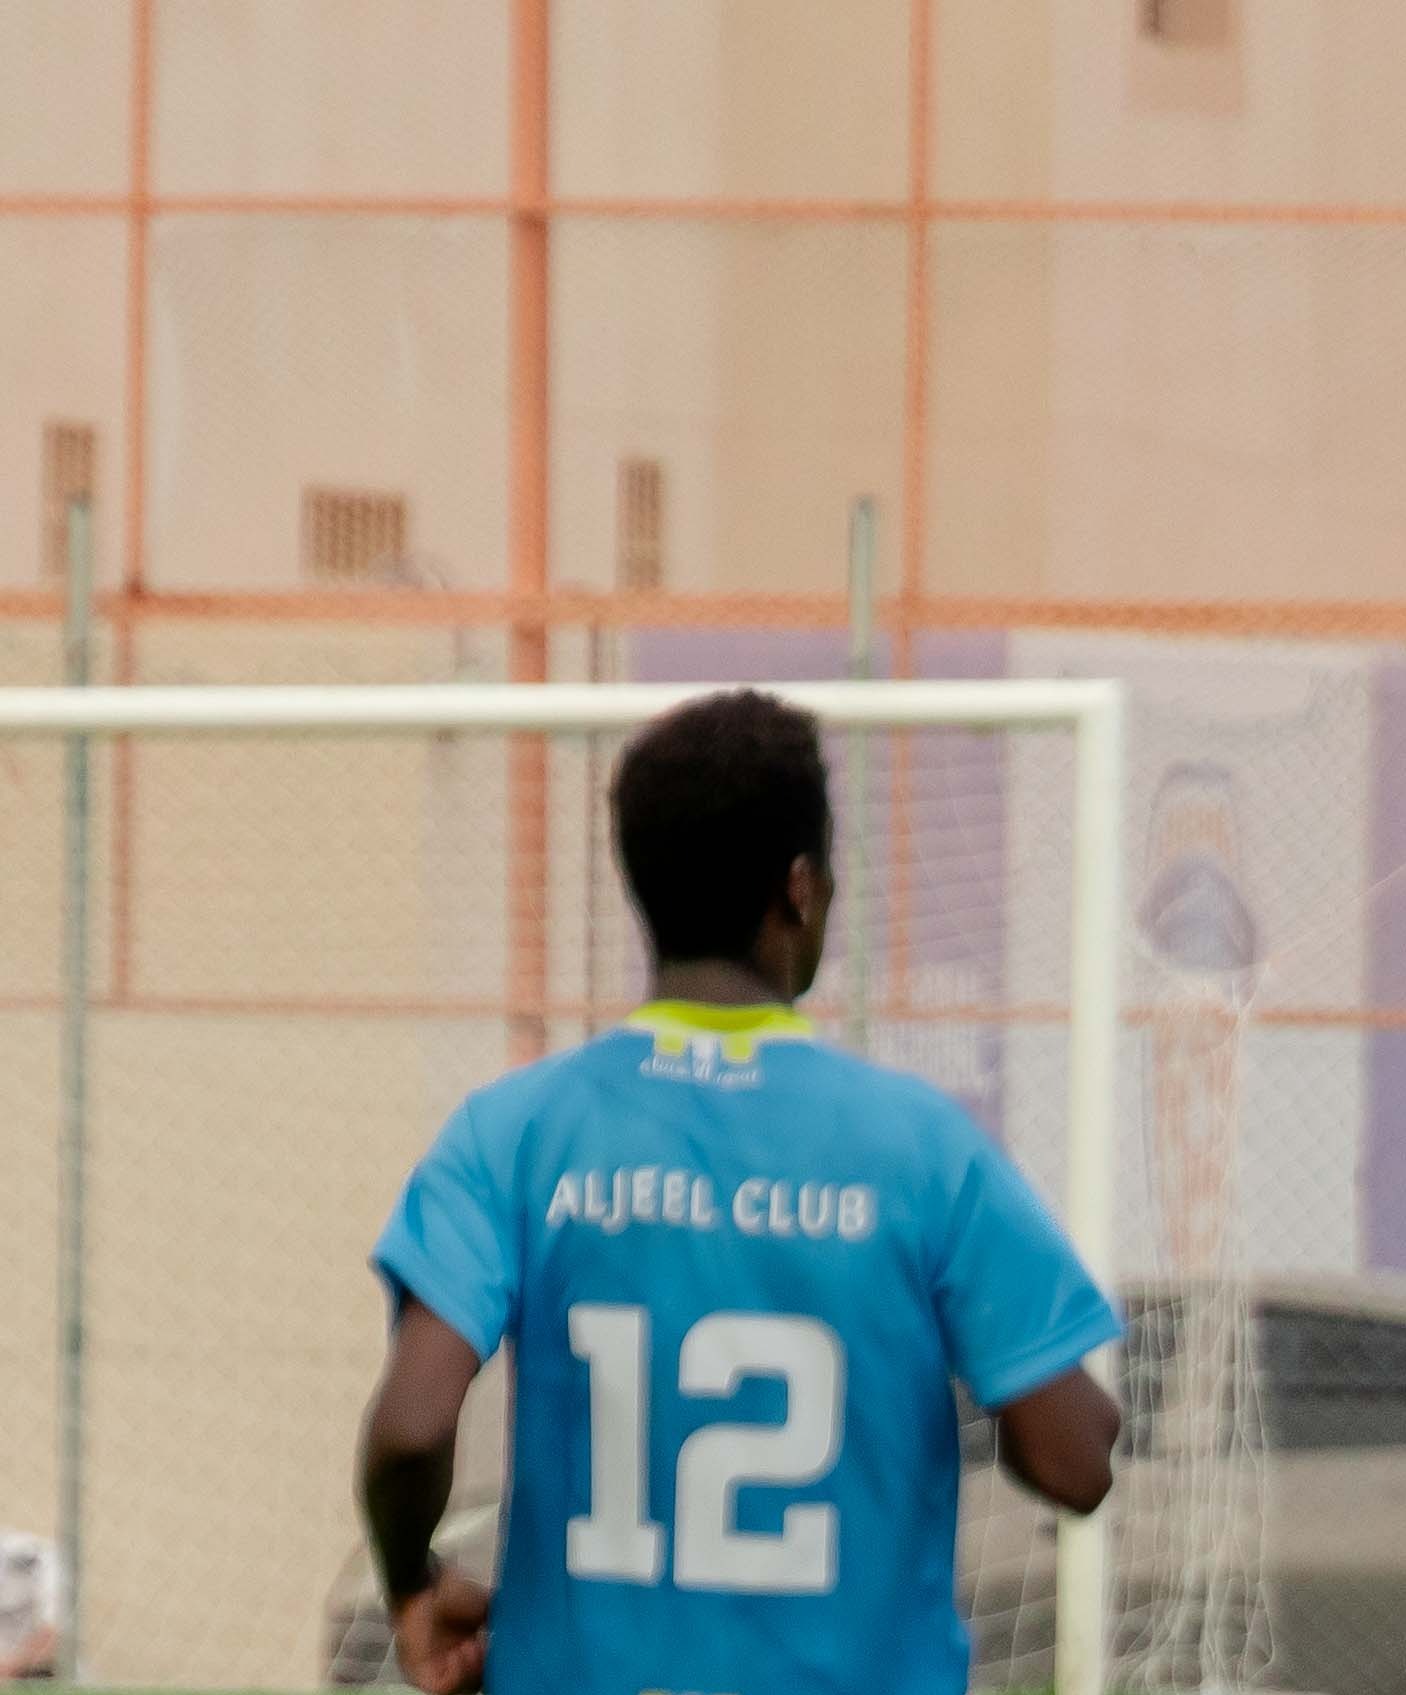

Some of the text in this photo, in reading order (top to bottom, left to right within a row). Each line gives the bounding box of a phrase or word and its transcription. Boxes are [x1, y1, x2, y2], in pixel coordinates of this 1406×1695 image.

[545, 1164, 875, 1242] ALJEEL CLUB
[566, 1302, 846, 1595] 12
